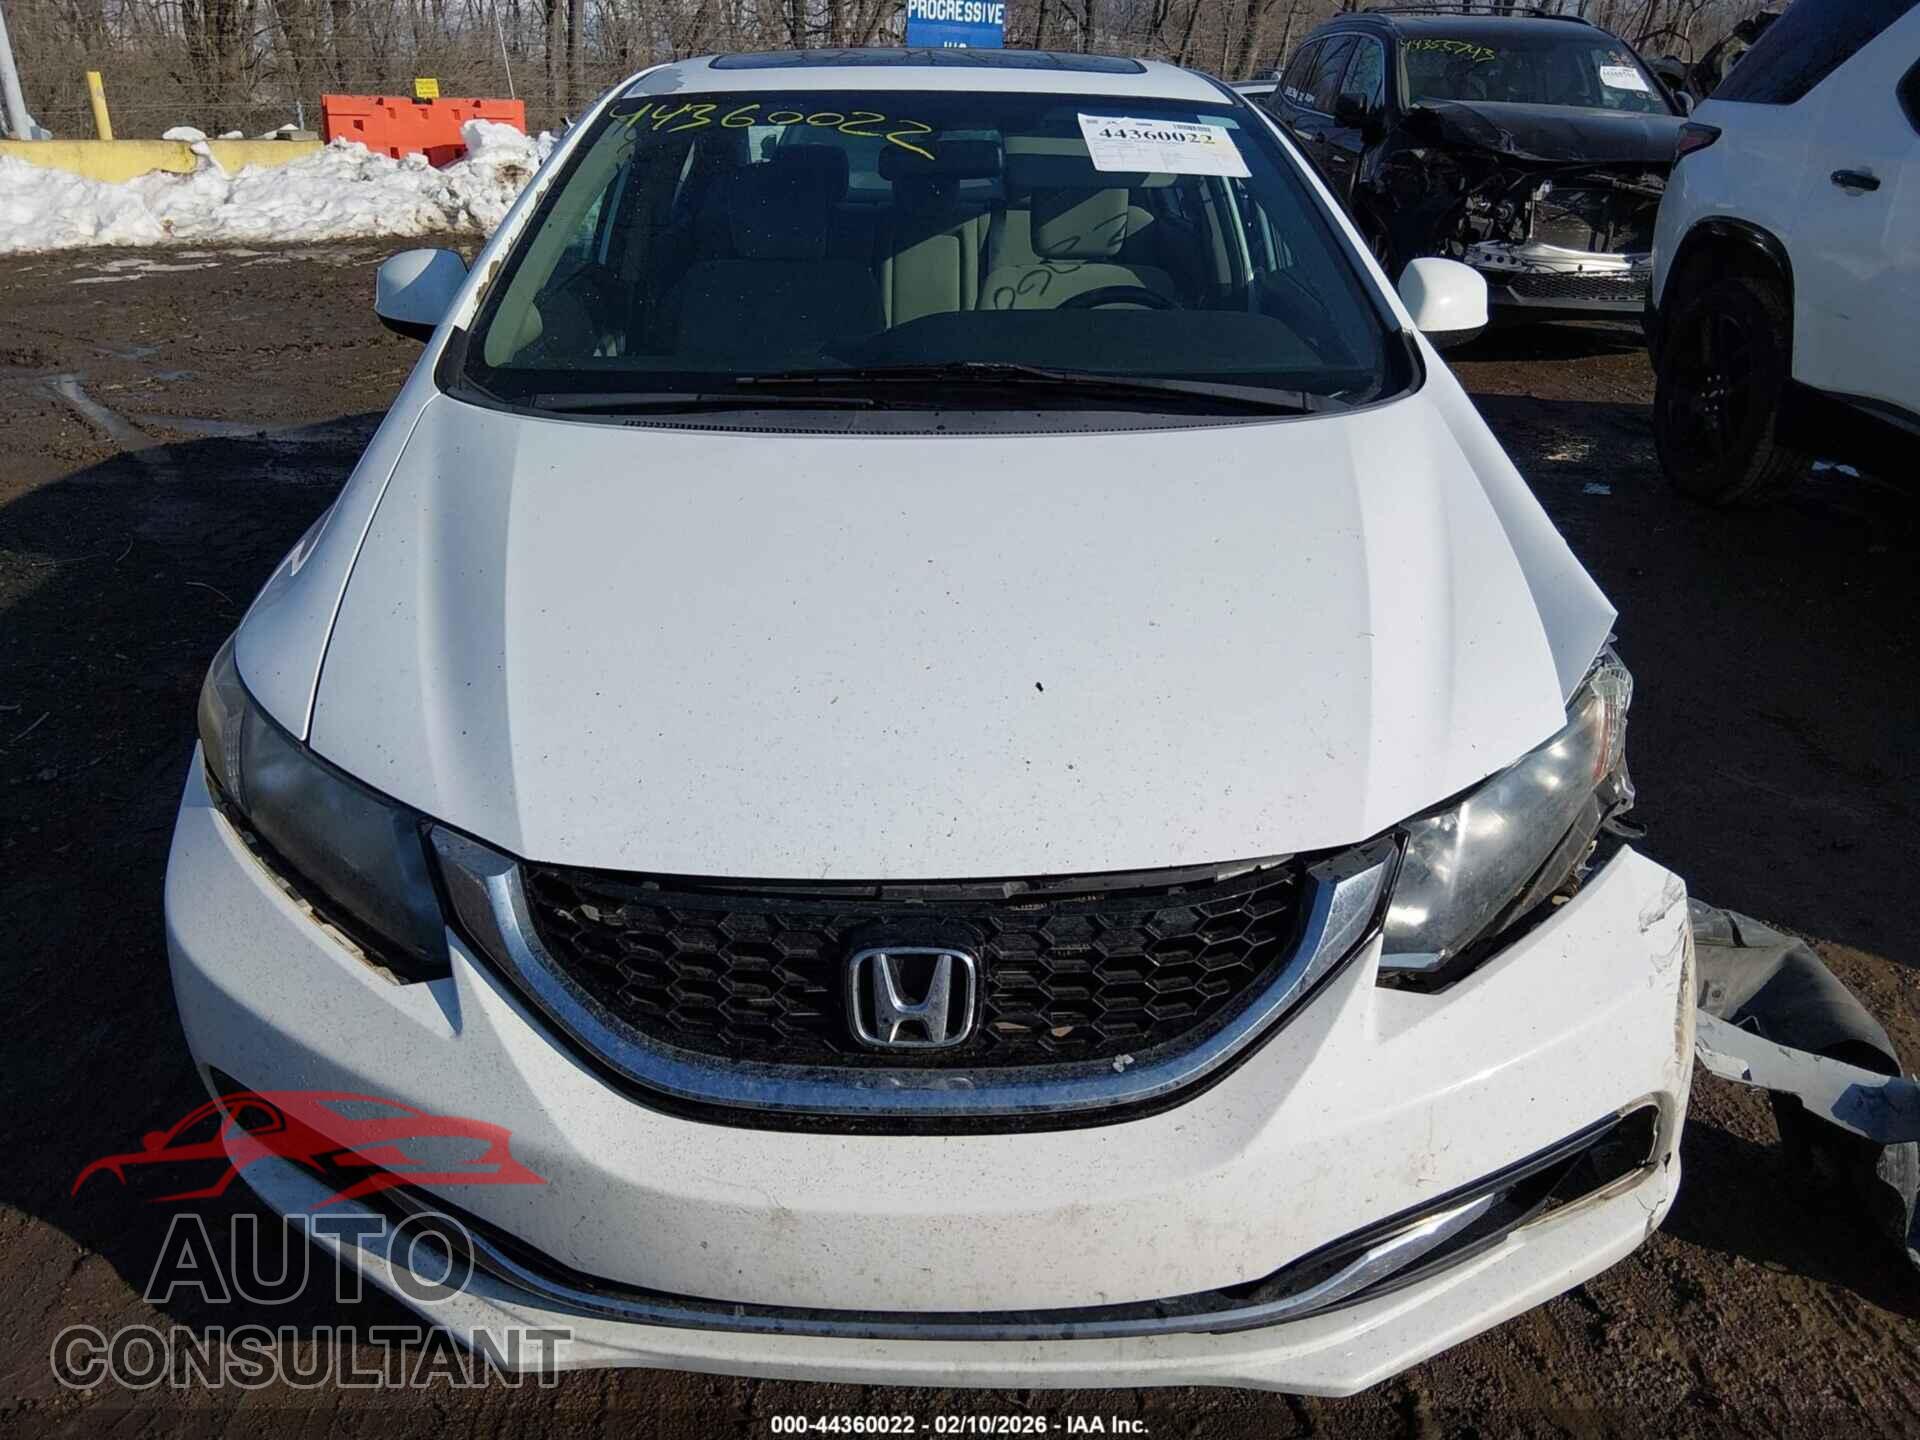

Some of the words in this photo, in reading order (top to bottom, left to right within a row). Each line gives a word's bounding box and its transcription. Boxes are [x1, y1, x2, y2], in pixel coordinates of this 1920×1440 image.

[908, 0, 1004, 24] PROGRESSIVE
[609, 103, 935, 160] 44360022
[1099, 127, 1216, 145] 44360022
